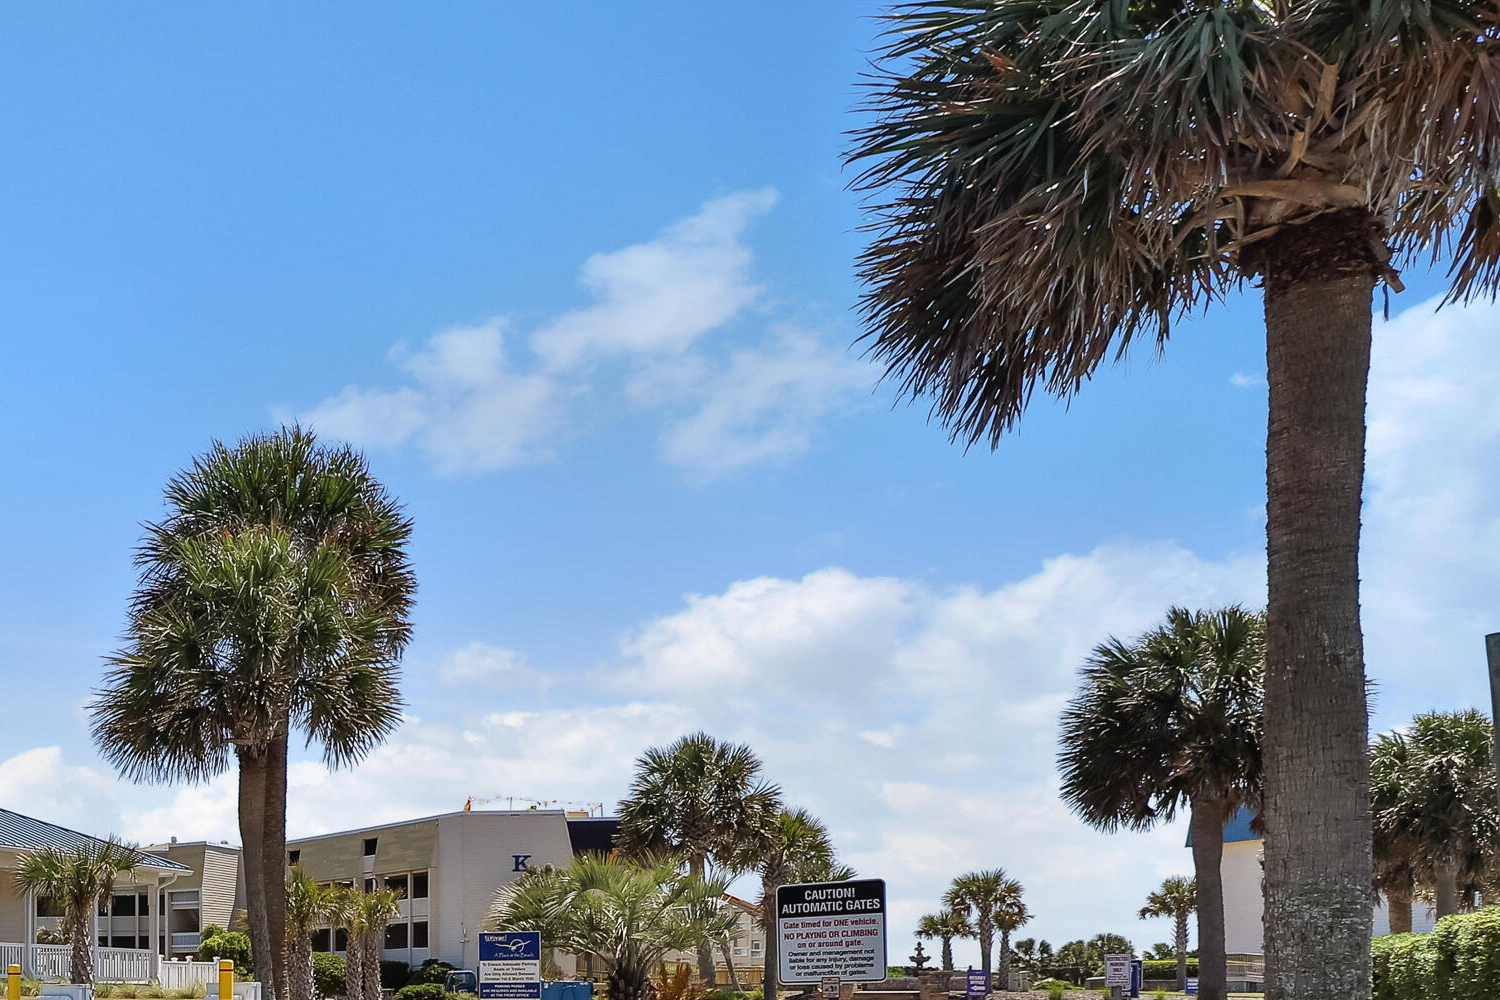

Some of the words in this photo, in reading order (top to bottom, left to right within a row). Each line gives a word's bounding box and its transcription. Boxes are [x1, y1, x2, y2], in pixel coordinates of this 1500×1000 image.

[512, 855, 532, 872] K
[805, 888, 855, 900] CAUTION!
[782, 901, 843, 914] AUTOMATIC
[846, 899, 880, 910] GATES
[851, 918, 878, 926] vehicle.
[842, 929, 878, 937] CLIMBING
